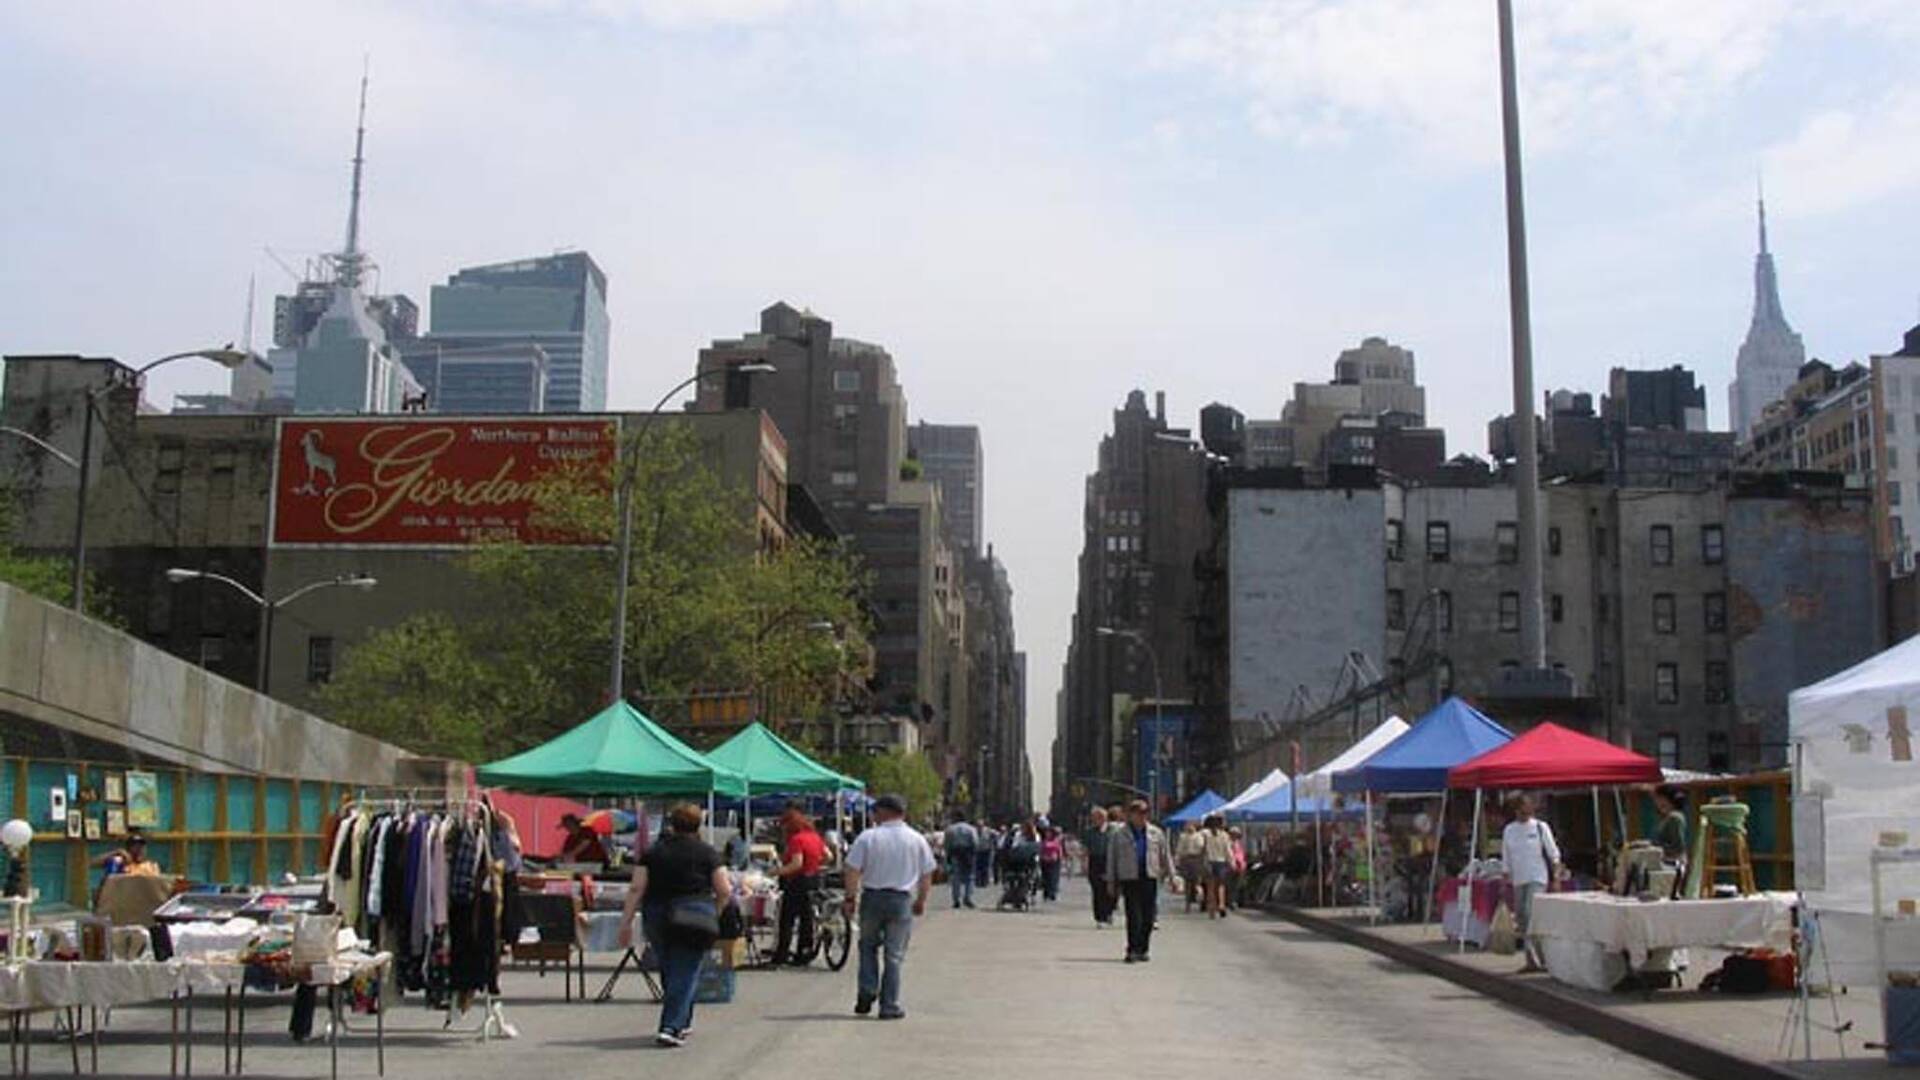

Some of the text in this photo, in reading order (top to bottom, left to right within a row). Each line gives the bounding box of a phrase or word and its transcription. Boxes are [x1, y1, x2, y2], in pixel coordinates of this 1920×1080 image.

[471, 427, 600, 442] Northern Italian
[324, 426, 560, 533] Giordan
